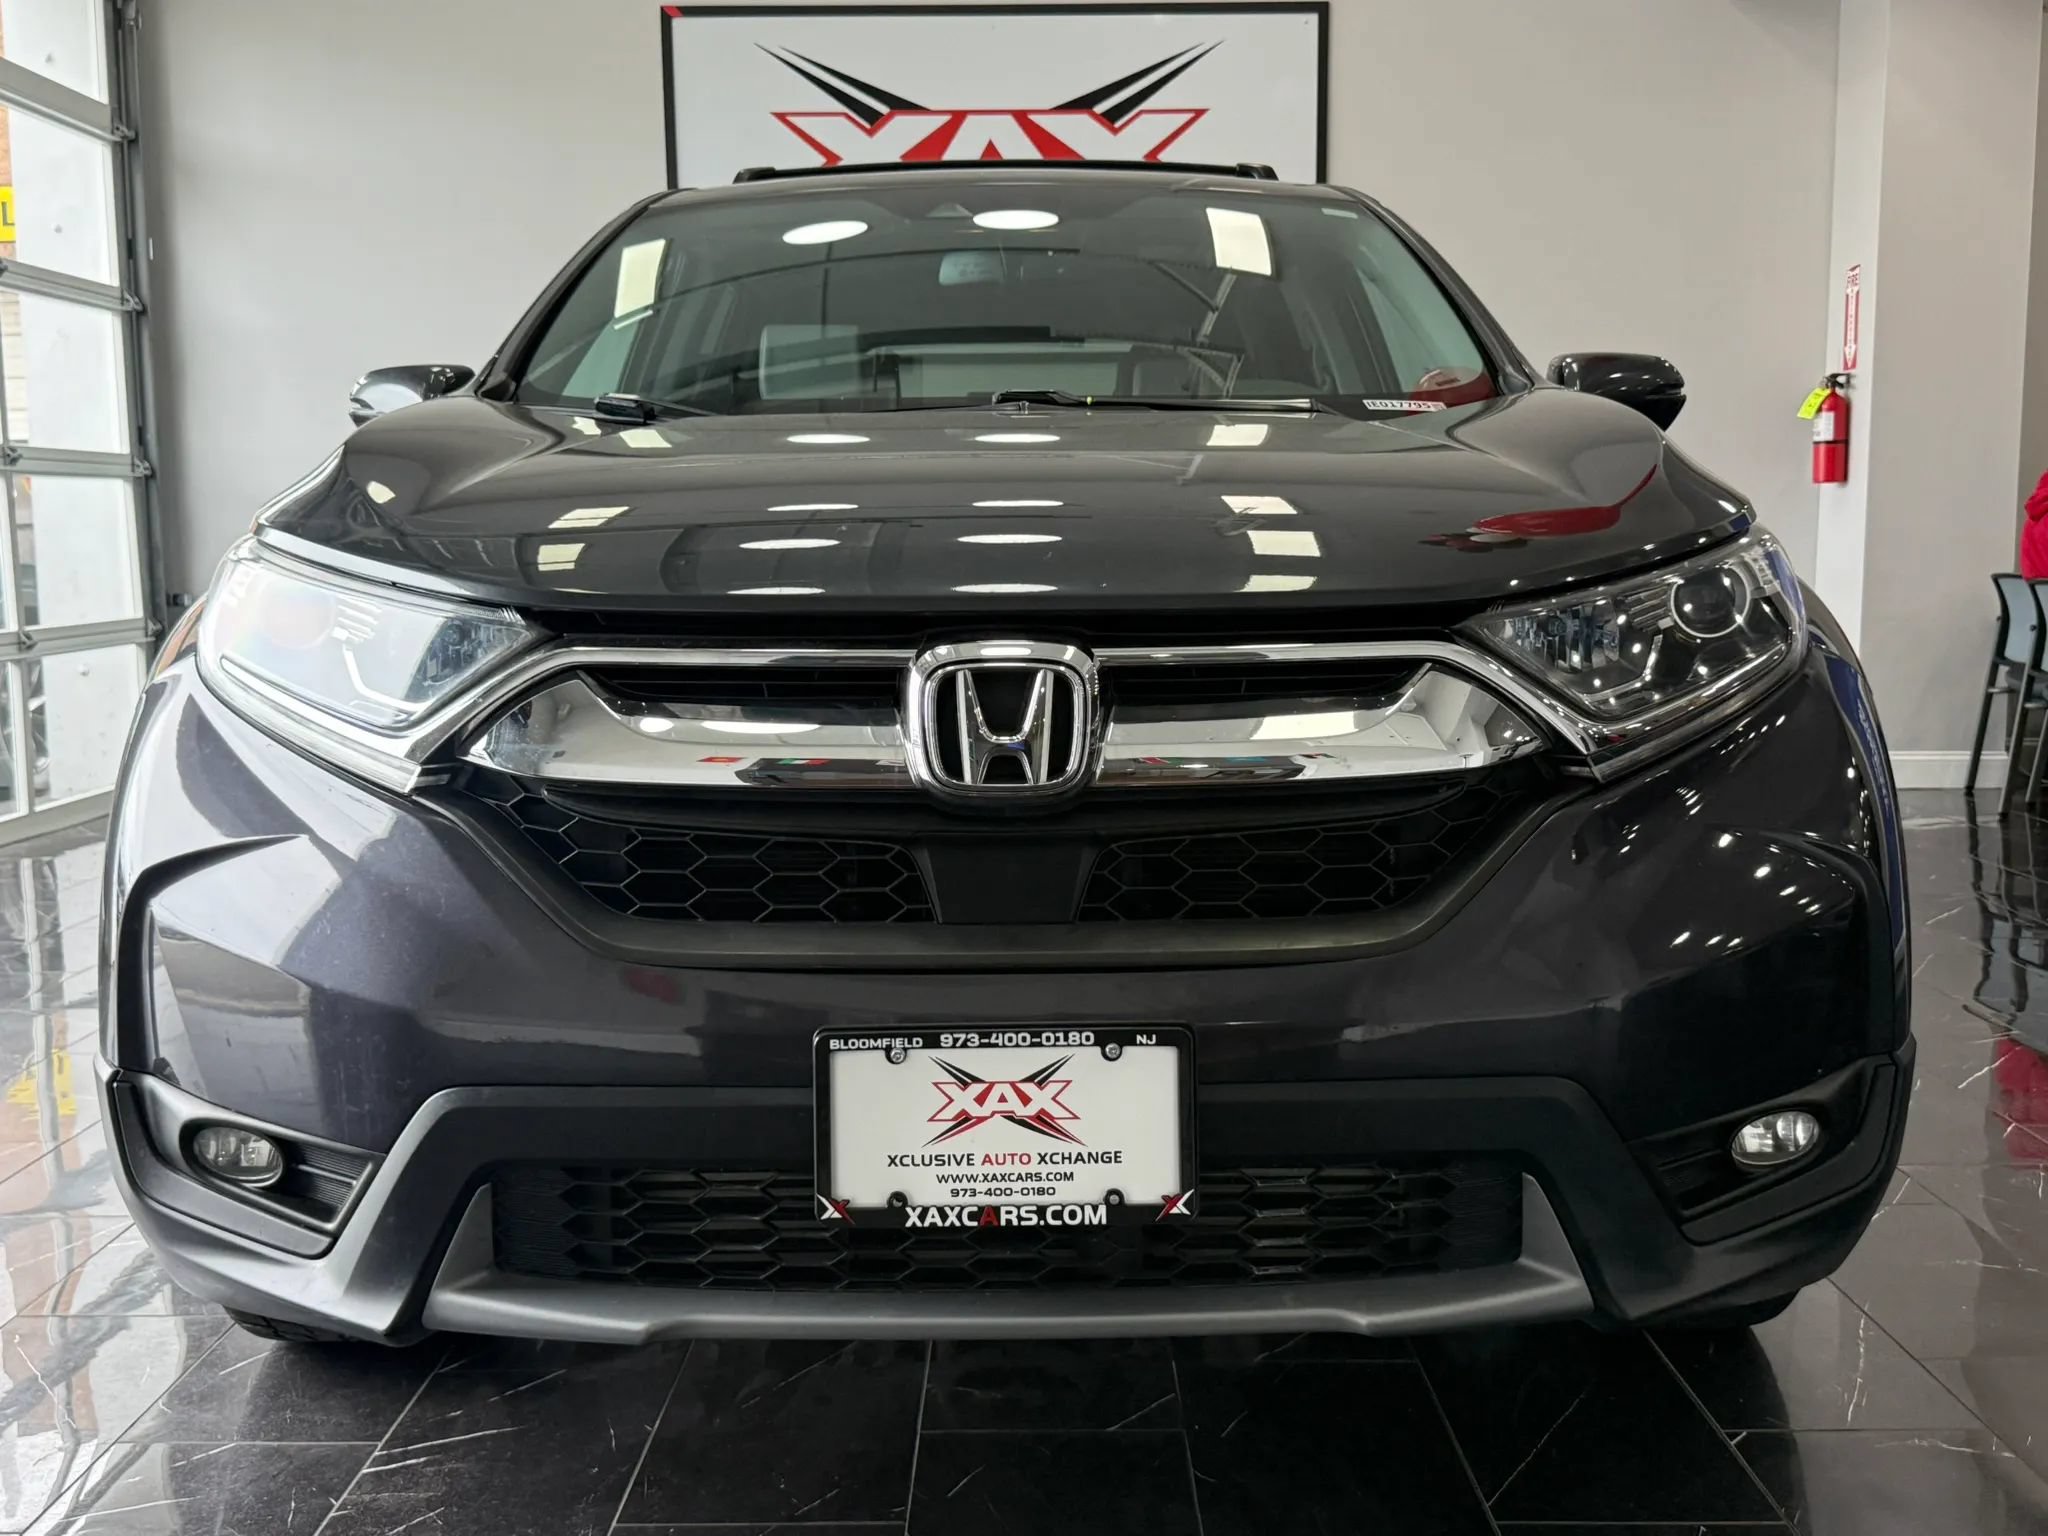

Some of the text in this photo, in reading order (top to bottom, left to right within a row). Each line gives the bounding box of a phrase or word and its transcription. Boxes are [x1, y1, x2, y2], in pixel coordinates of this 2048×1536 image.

[829, 1032, 1157, 1050] BLOOMFIELD 973-400-0180 NJ
[927, 1080, 1081, 1122] XAX
[888, 1150, 1122, 1167] XCLUSIVE AUTO XCHANGE
[936, 1171, 1074, 1184] WWW.XAXCARS.COM
[950, 1187, 1056, 1197] 973-400-0180
[905, 1204, 1107, 1227] XAXCARS.COM
